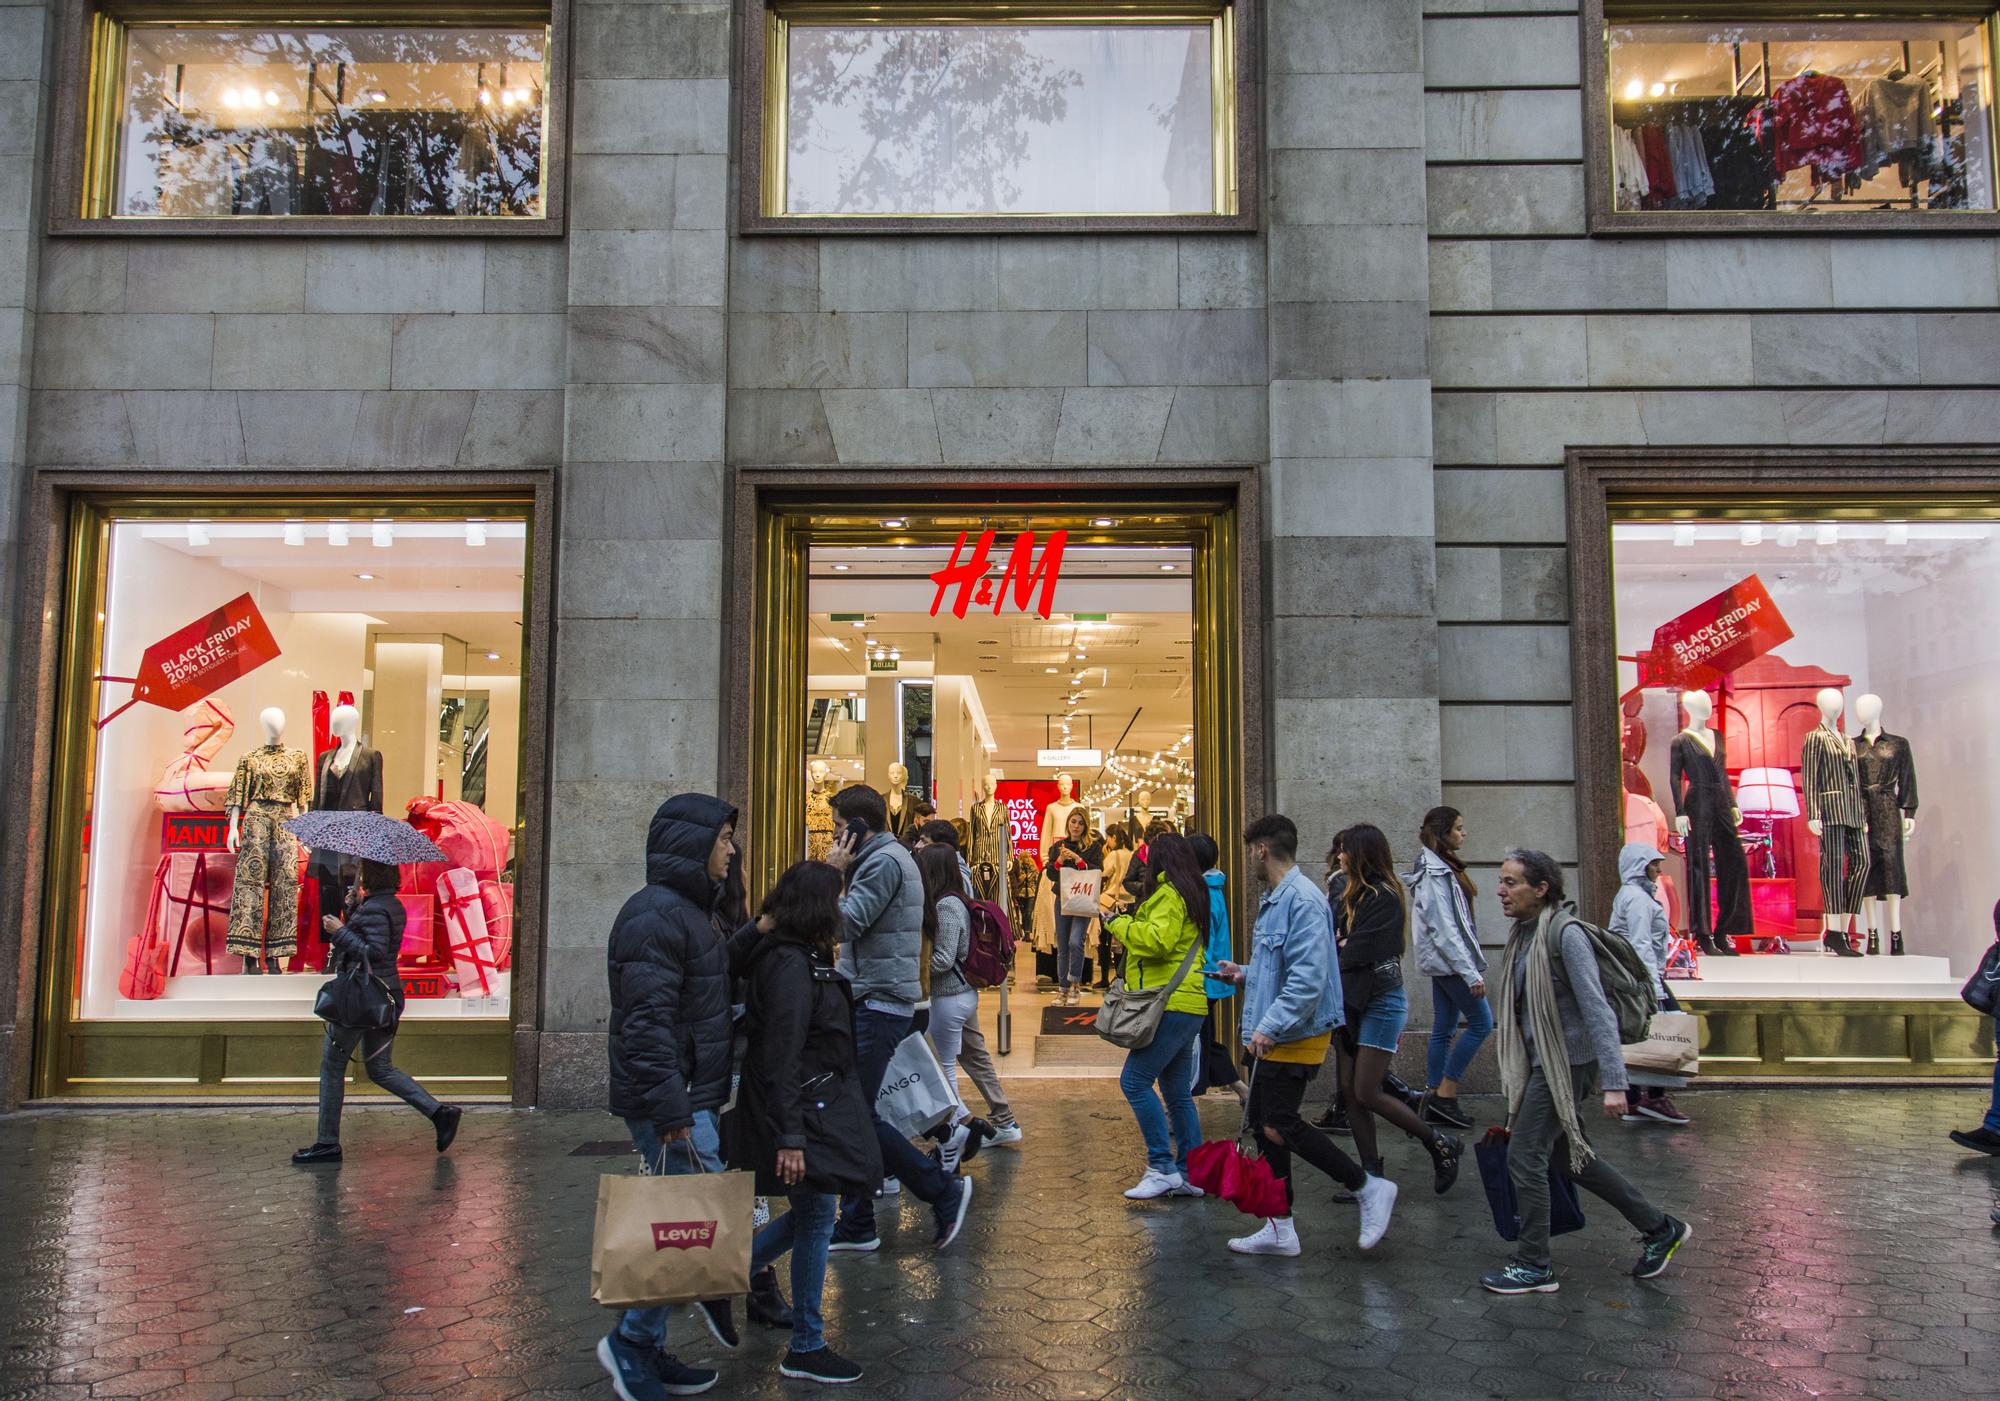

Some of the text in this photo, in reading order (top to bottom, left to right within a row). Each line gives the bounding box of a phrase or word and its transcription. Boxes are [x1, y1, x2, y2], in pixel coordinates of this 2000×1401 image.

[930, 529, 1068, 620] H&M
[161, 616, 251, 674] BLACK FRIDAY
[1673, 597, 1761, 655] BLACK FRIDAY
[1680, 626, 1742, 665] 20% DTE.
[167, 645, 230, 685] 20% DTE.
[1007, 799, 1034, 809] ACK
[1010, 809, 1037, 820] DAY
[1009, 820, 1038, 841] 0%
[876, 1073, 920, 1100] ANGO
